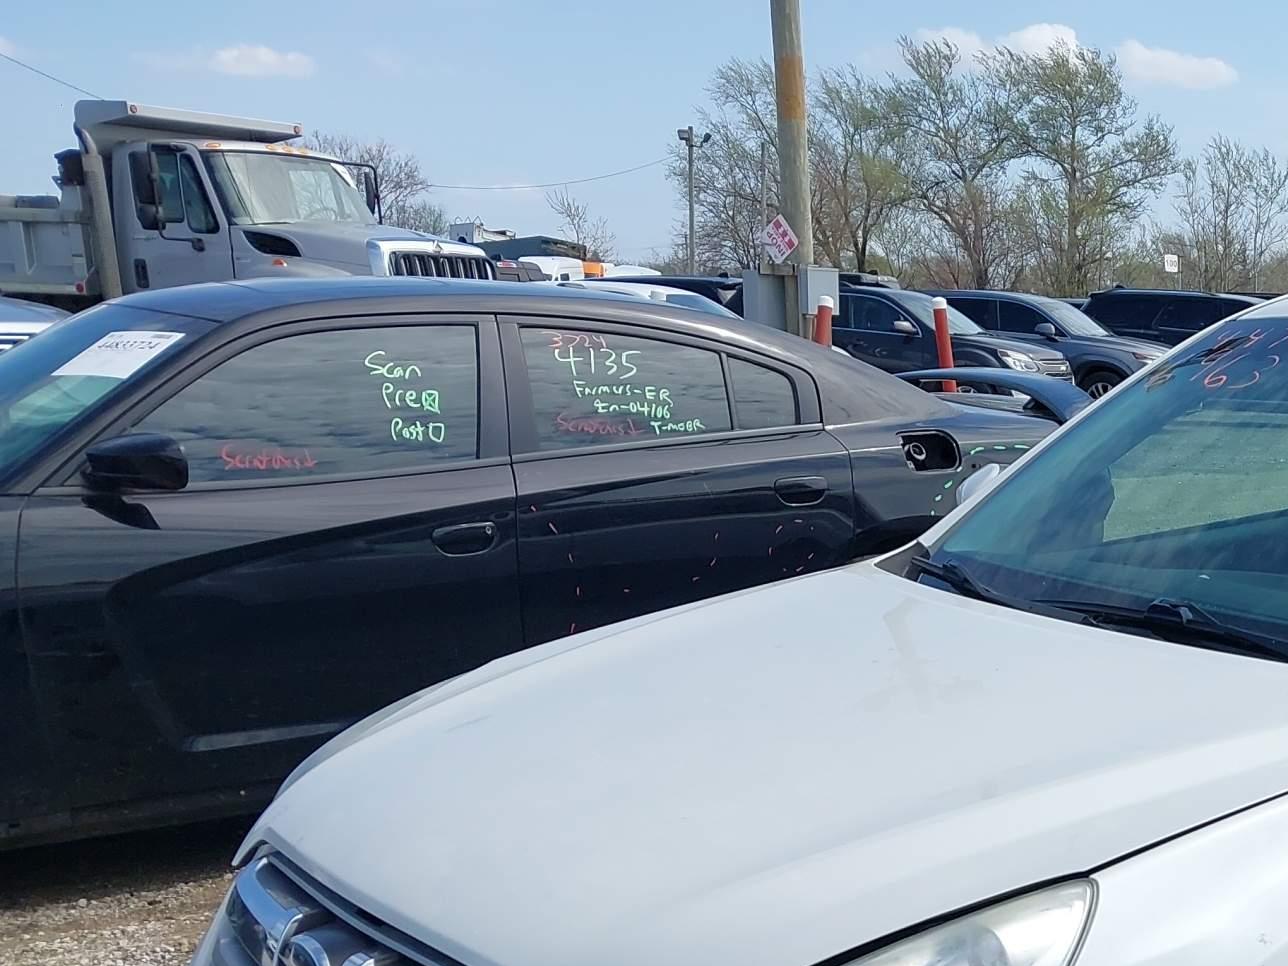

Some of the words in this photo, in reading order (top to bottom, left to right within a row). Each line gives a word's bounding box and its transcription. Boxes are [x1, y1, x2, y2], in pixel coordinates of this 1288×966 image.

[767, 231, 786, 257] INOP
[364, 350, 422, 379] Scan
[554, 346, 641, 379] 4135
[382, 382, 421, 409] Pre
[391, 417, 425, 441] Post
